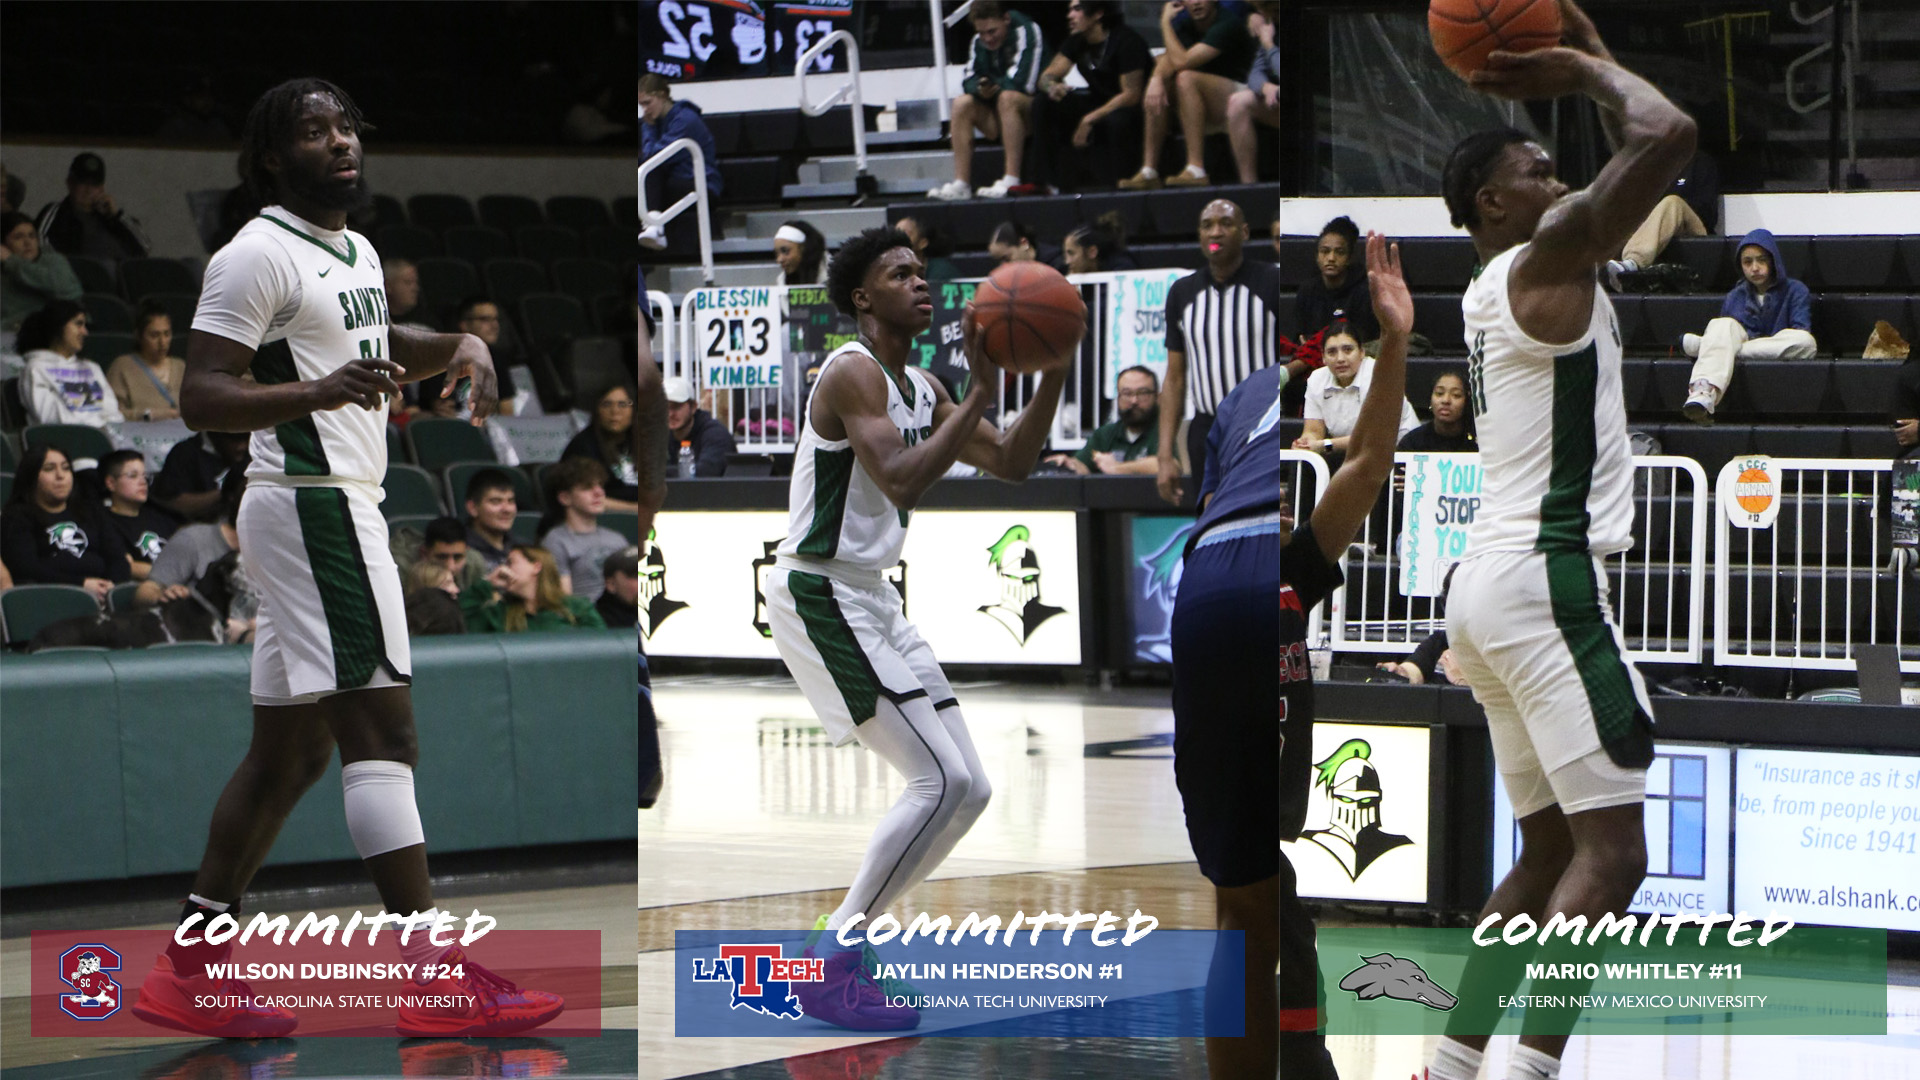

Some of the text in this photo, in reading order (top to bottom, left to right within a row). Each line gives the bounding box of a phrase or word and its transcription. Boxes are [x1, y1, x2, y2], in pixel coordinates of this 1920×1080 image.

[696, 288, 770, 310] BLESSIN
[709, 364, 782, 387] KIMBLE
[1435, 495, 1481, 525] STOP
[1860, 770, 1881, 788] as
[1887, 768, 1900, 789] it
[1738, 792, 1766, 814] be,
[1773, 794, 1815, 816] from
[1820, 800, 1886, 823] people
[1800, 826, 1917, 854] Since 1941
[1764, 885, 1920, 912] www.alshank.c
